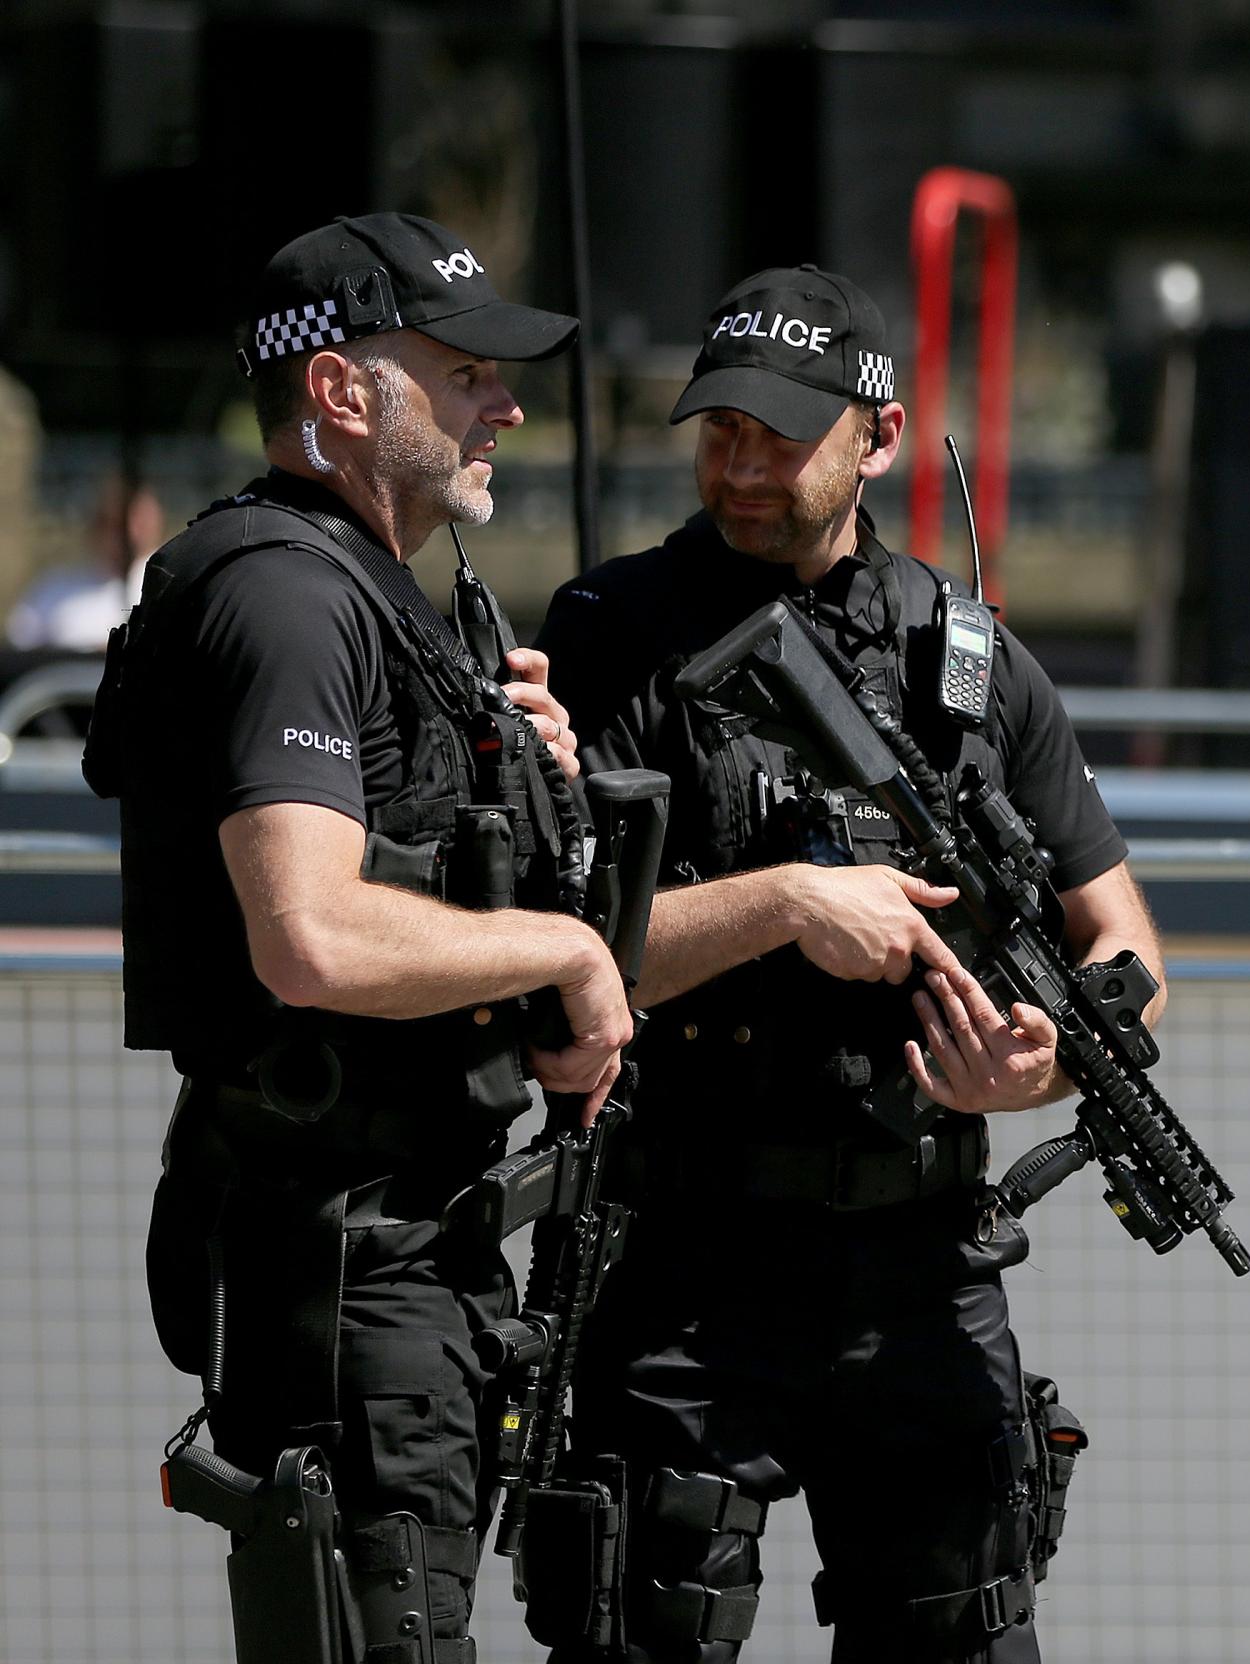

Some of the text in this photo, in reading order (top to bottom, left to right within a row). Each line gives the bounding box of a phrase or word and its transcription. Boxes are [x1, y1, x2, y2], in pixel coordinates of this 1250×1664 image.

[431, 248, 485, 283] POL
[711, 310, 832, 355] POLICE
[283, 728, 353, 760] POLICE
